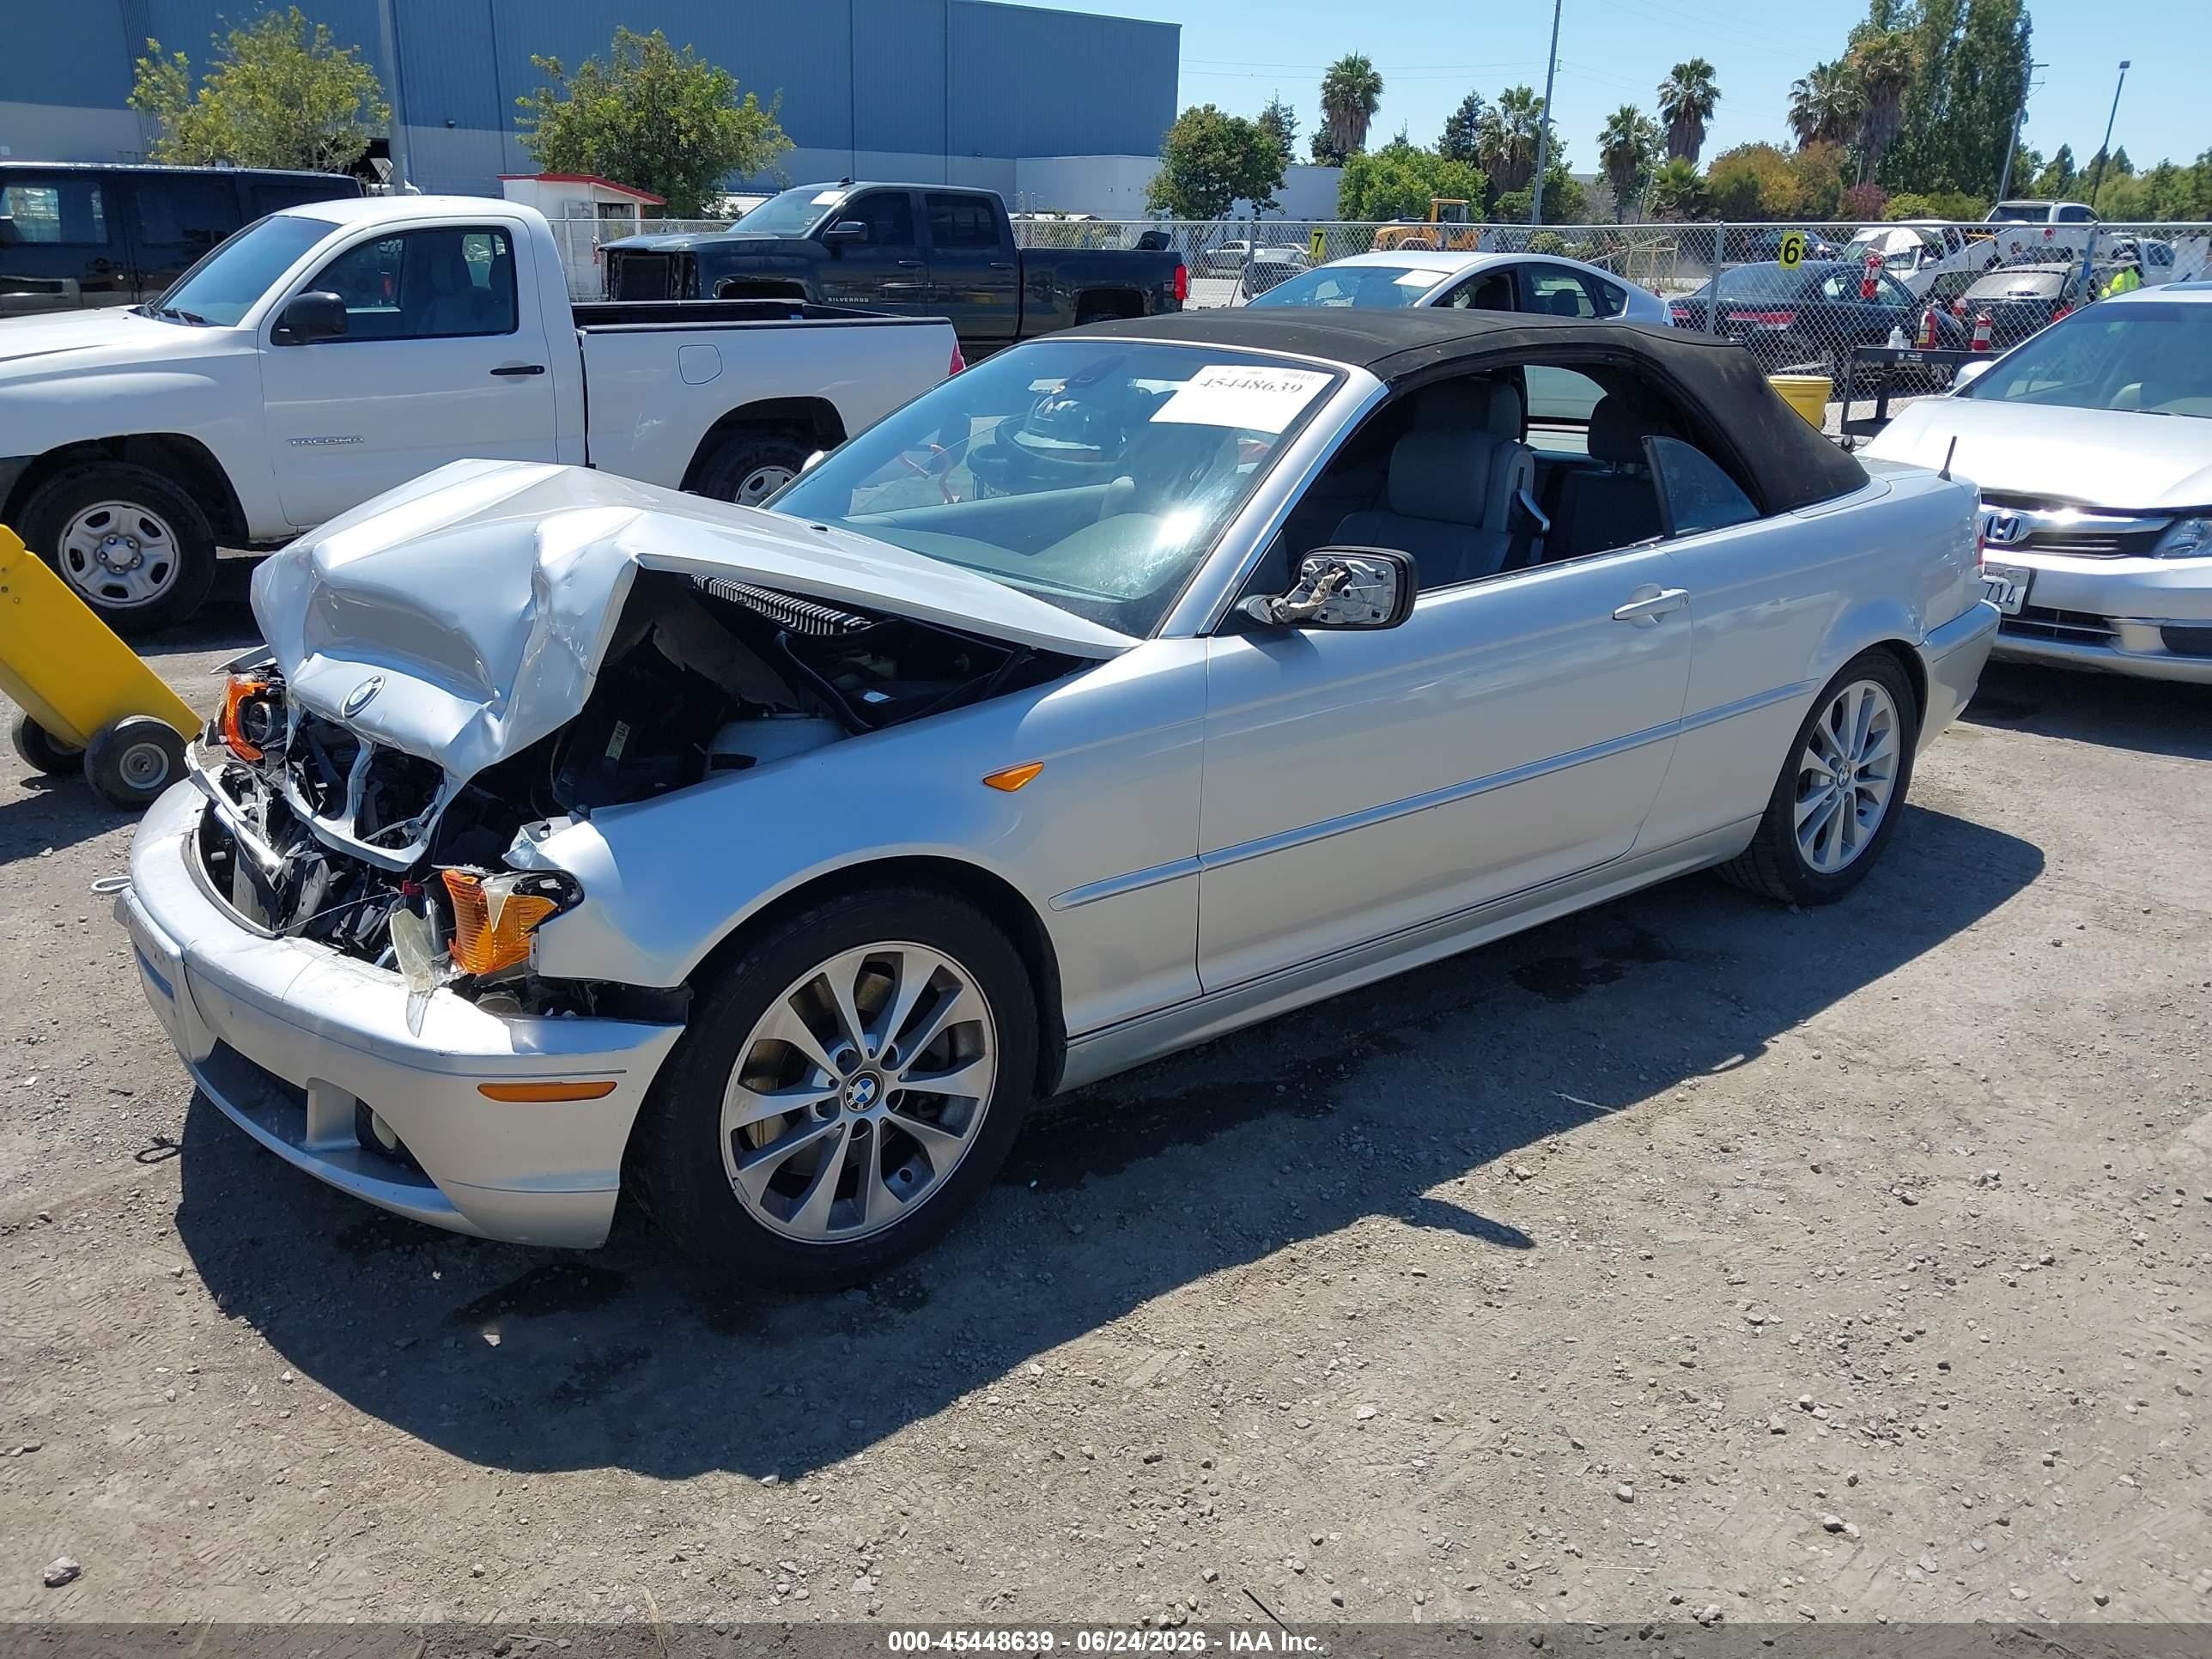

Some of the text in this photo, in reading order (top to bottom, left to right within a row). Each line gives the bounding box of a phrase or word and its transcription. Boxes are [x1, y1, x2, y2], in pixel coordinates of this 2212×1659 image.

[1314, 233, 1324, 253] 7
[1784, 237, 1800, 264] 6
[1200, 377, 1304, 394] 45448639
[287, 434, 365, 447] TACOMA
